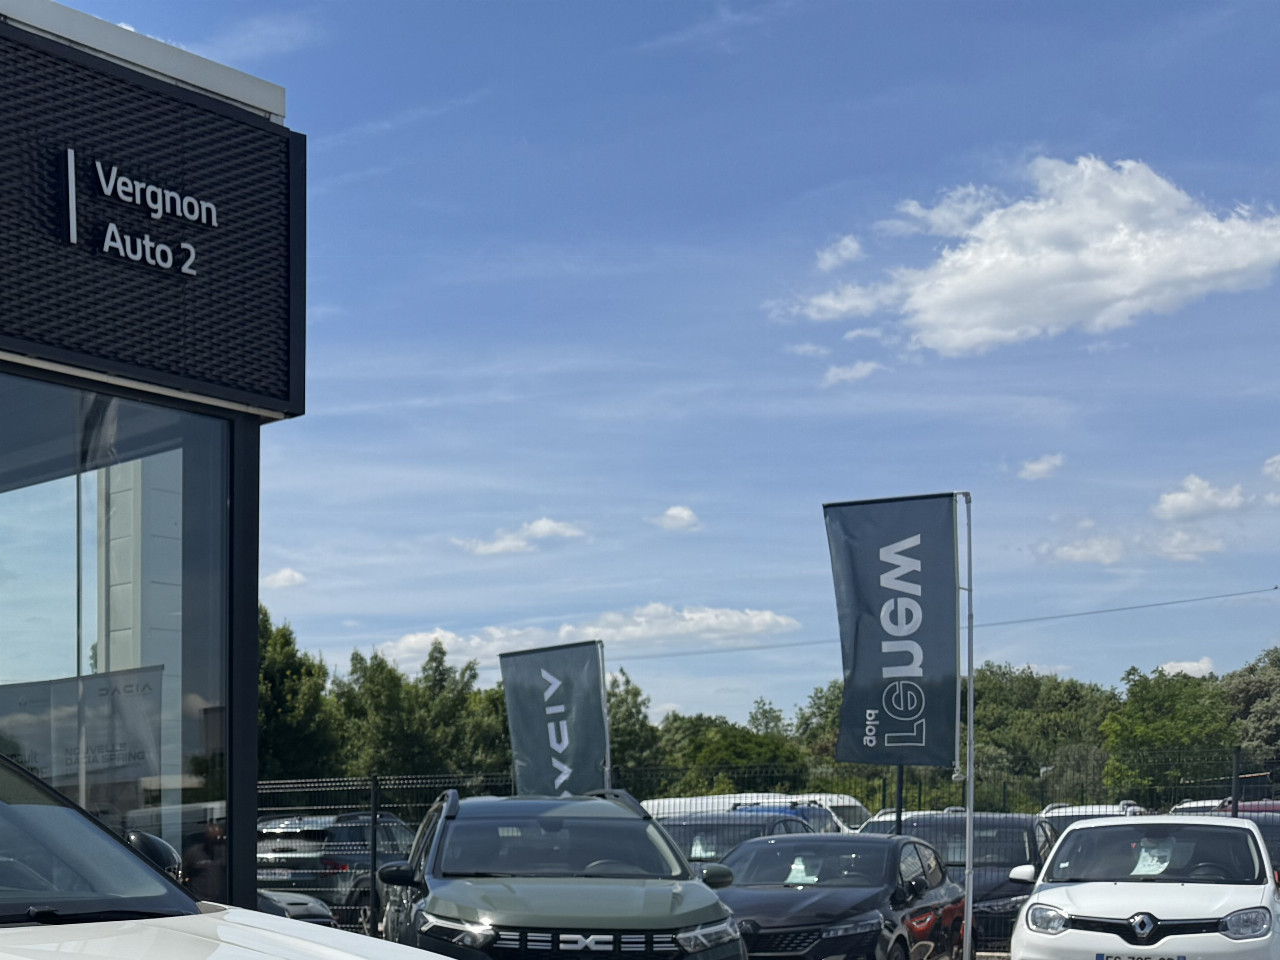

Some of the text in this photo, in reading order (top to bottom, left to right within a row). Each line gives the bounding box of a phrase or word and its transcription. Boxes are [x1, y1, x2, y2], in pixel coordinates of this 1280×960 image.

[95, 160, 218, 227] Vergnon
[103, 222, 198, 276] Auto 2
[98, 683, 152, 697] DACIA
[102, 751, 145, 763] SPRING
